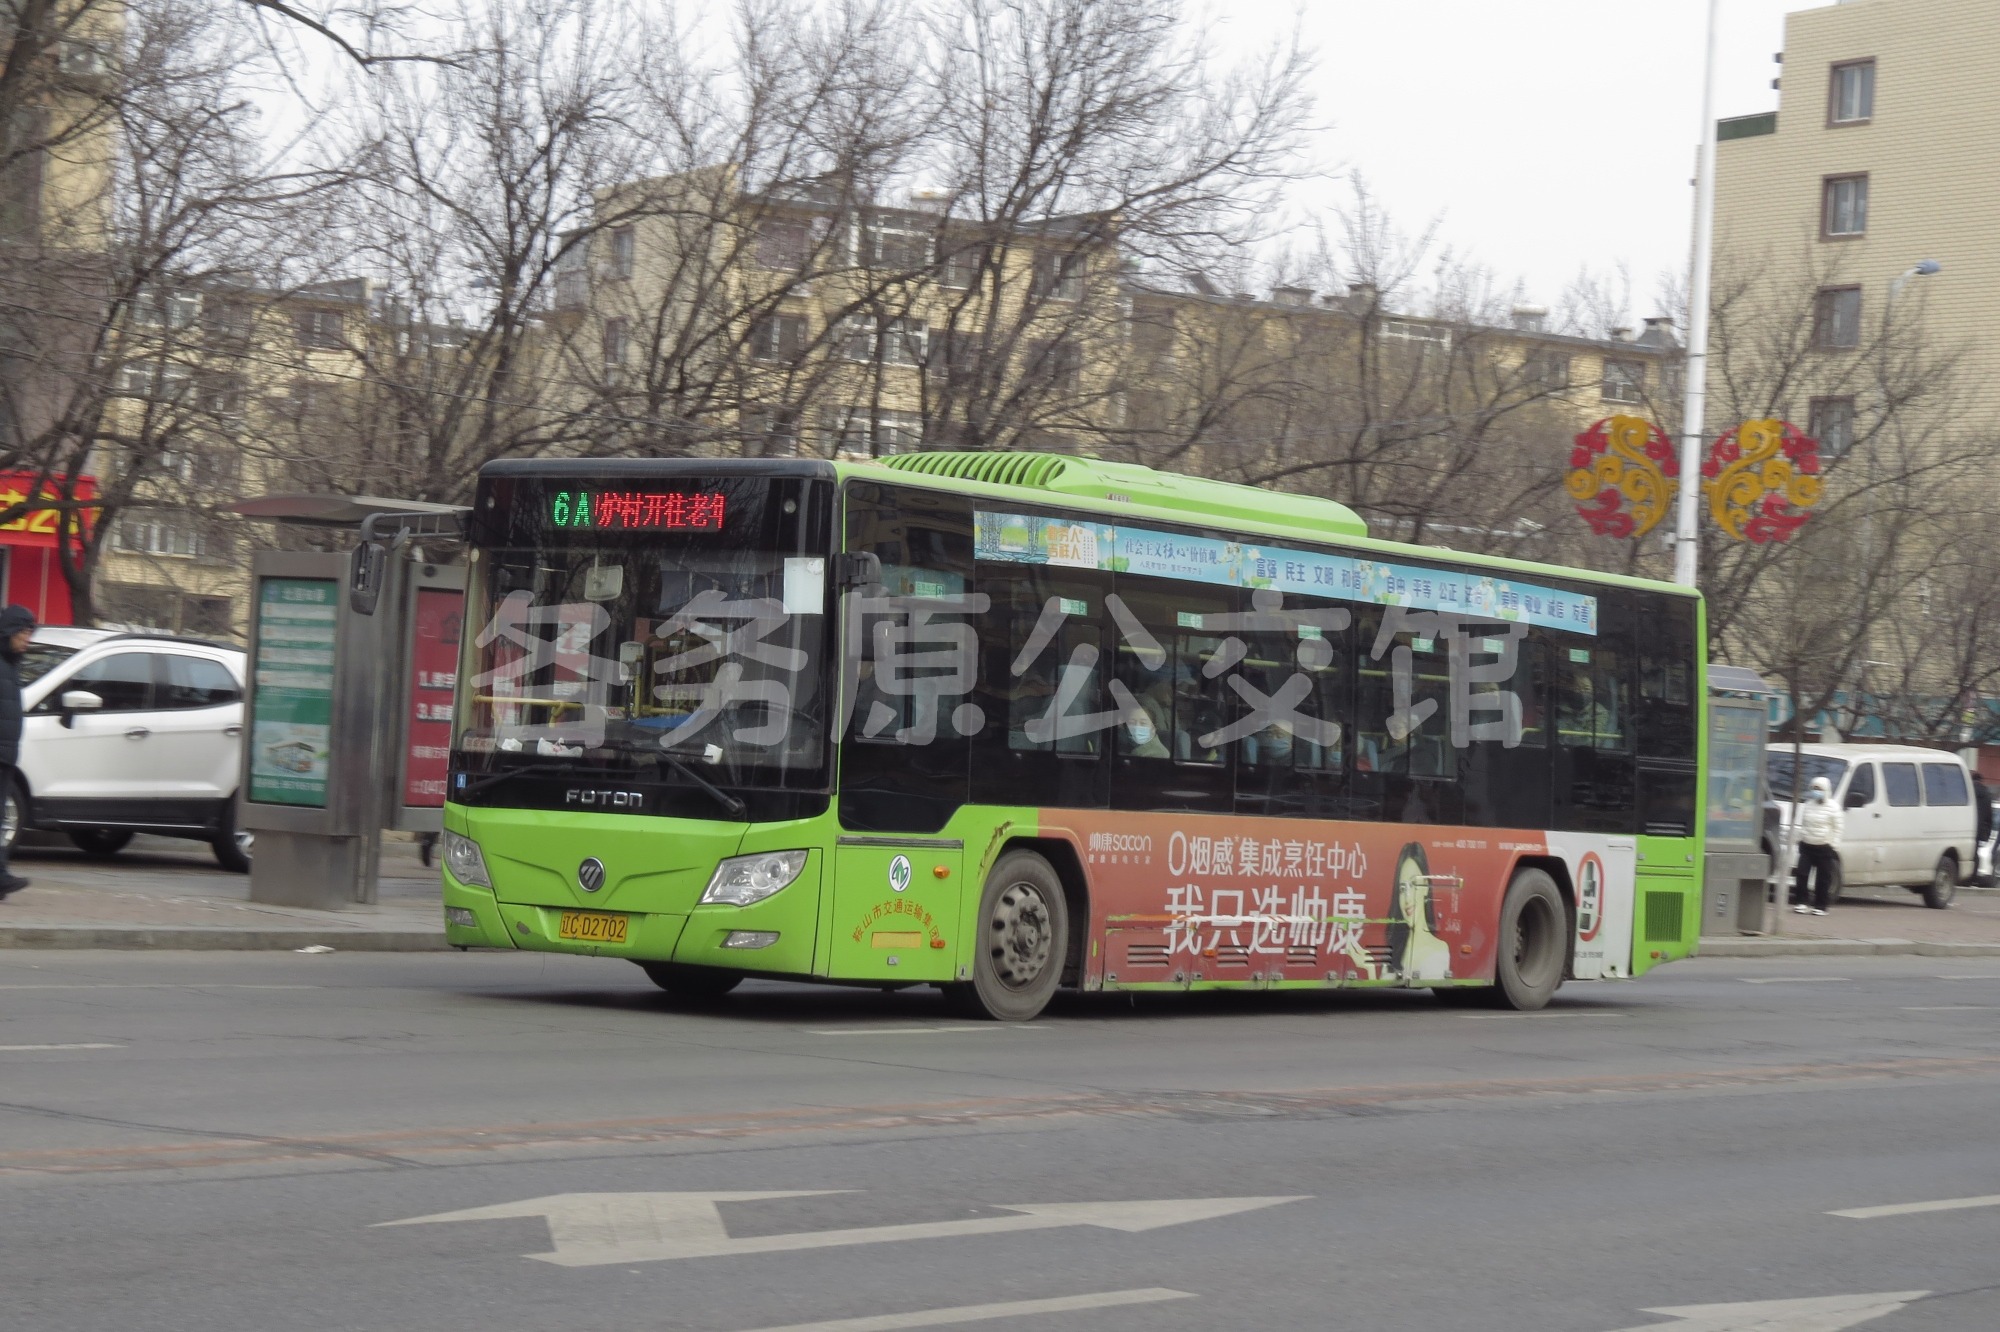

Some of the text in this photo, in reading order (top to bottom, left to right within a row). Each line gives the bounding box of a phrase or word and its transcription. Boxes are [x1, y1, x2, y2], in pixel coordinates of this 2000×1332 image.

[554, 492, 591, 527] 6A
[1256, 558, 1277, 579] 富强
[1286, 561, 1306, 582] 民主
[1314, 565, 1334, 586] 文明
[566, 789, 643, 808] FOTON
[1163, 883, 1368, 956] 我只选帅康
